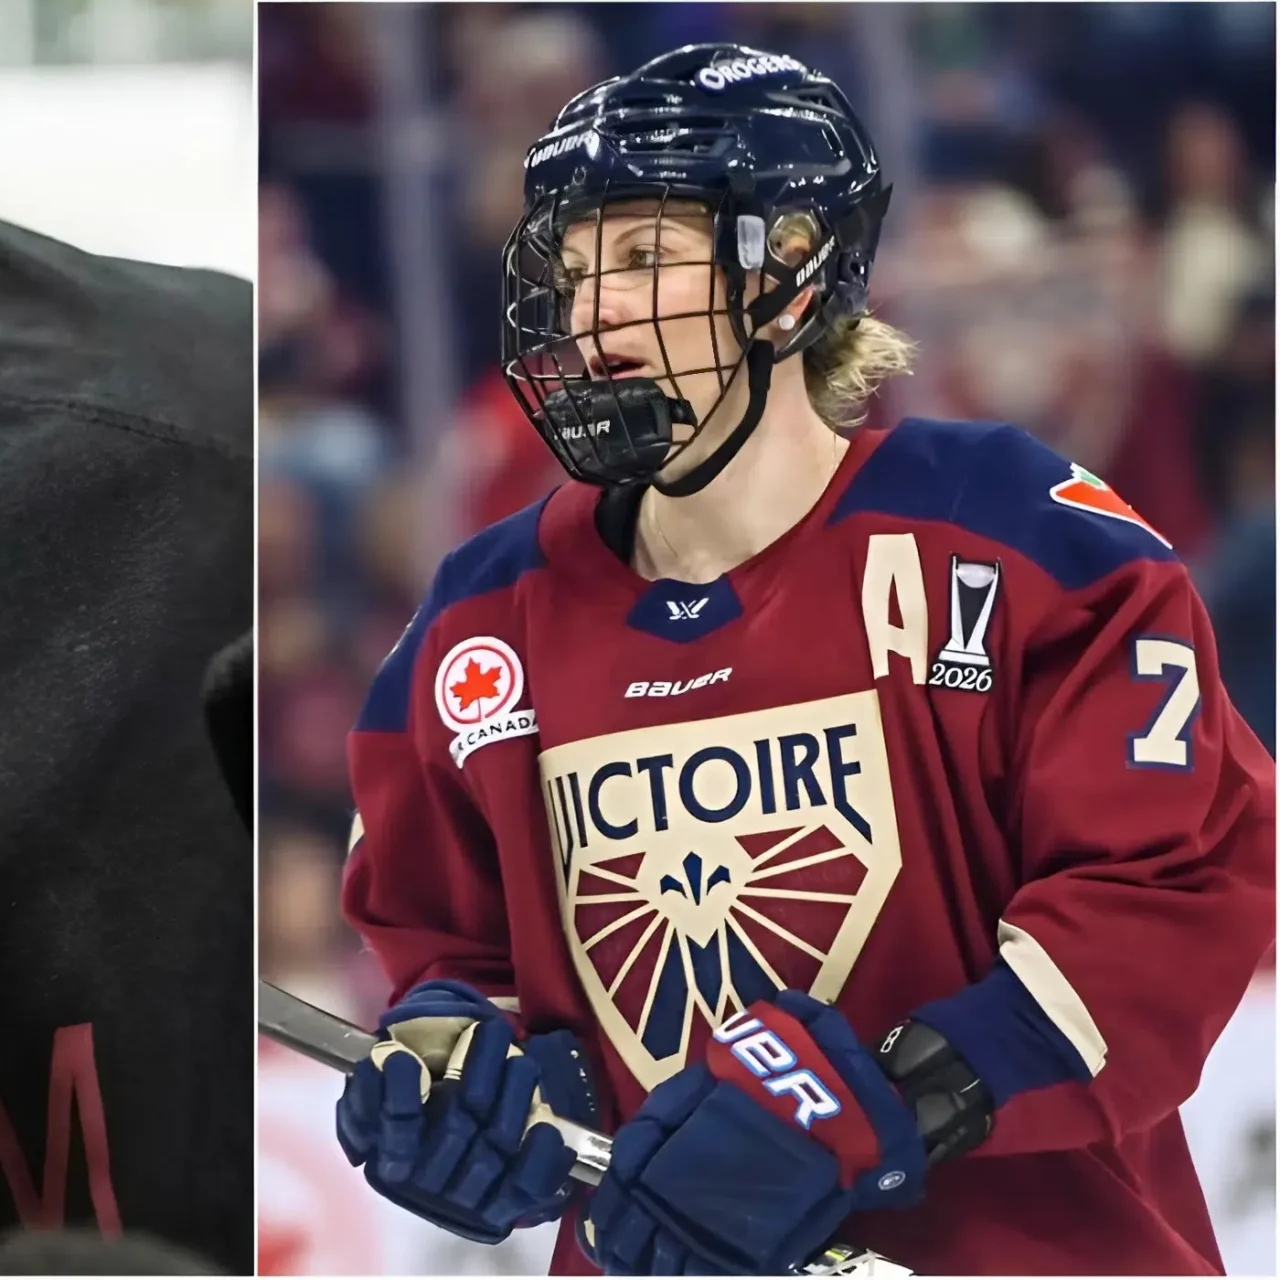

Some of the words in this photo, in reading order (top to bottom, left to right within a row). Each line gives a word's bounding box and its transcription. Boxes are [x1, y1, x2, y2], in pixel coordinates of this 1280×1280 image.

[861, 532, 928, 686] A
[624, 666, 734, 698] BAUER
[928, 662, 993, 693] 2026
[1128, 635, 1201, 771] 7
